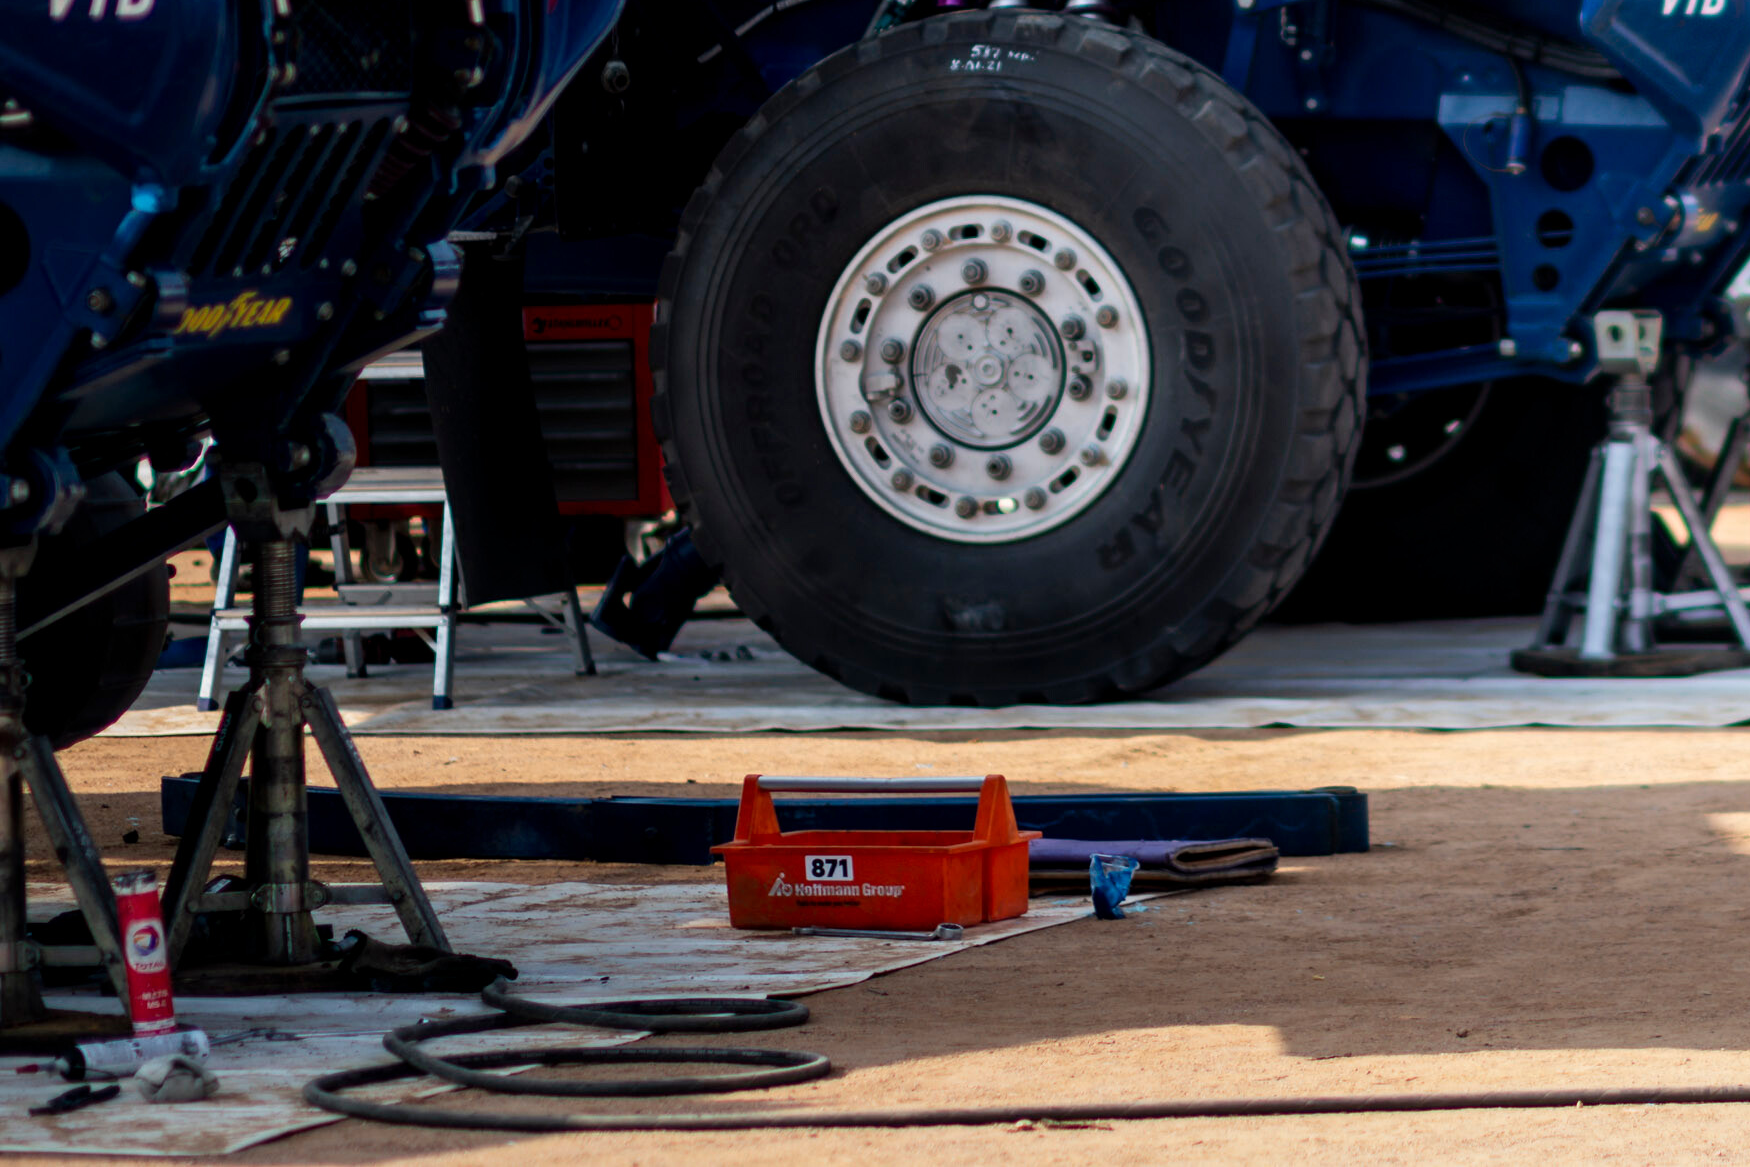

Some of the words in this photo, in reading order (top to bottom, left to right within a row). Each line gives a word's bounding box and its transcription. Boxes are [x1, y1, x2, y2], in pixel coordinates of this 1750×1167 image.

[173, 290, 294, 339] OODYEAR
[1096, 205, 1218, 572] GOODYEAR
[811, 858, 849, 879] 871
[795, 883, 860, 897] Hoffmann
[862, 883, 903, 899] Group
